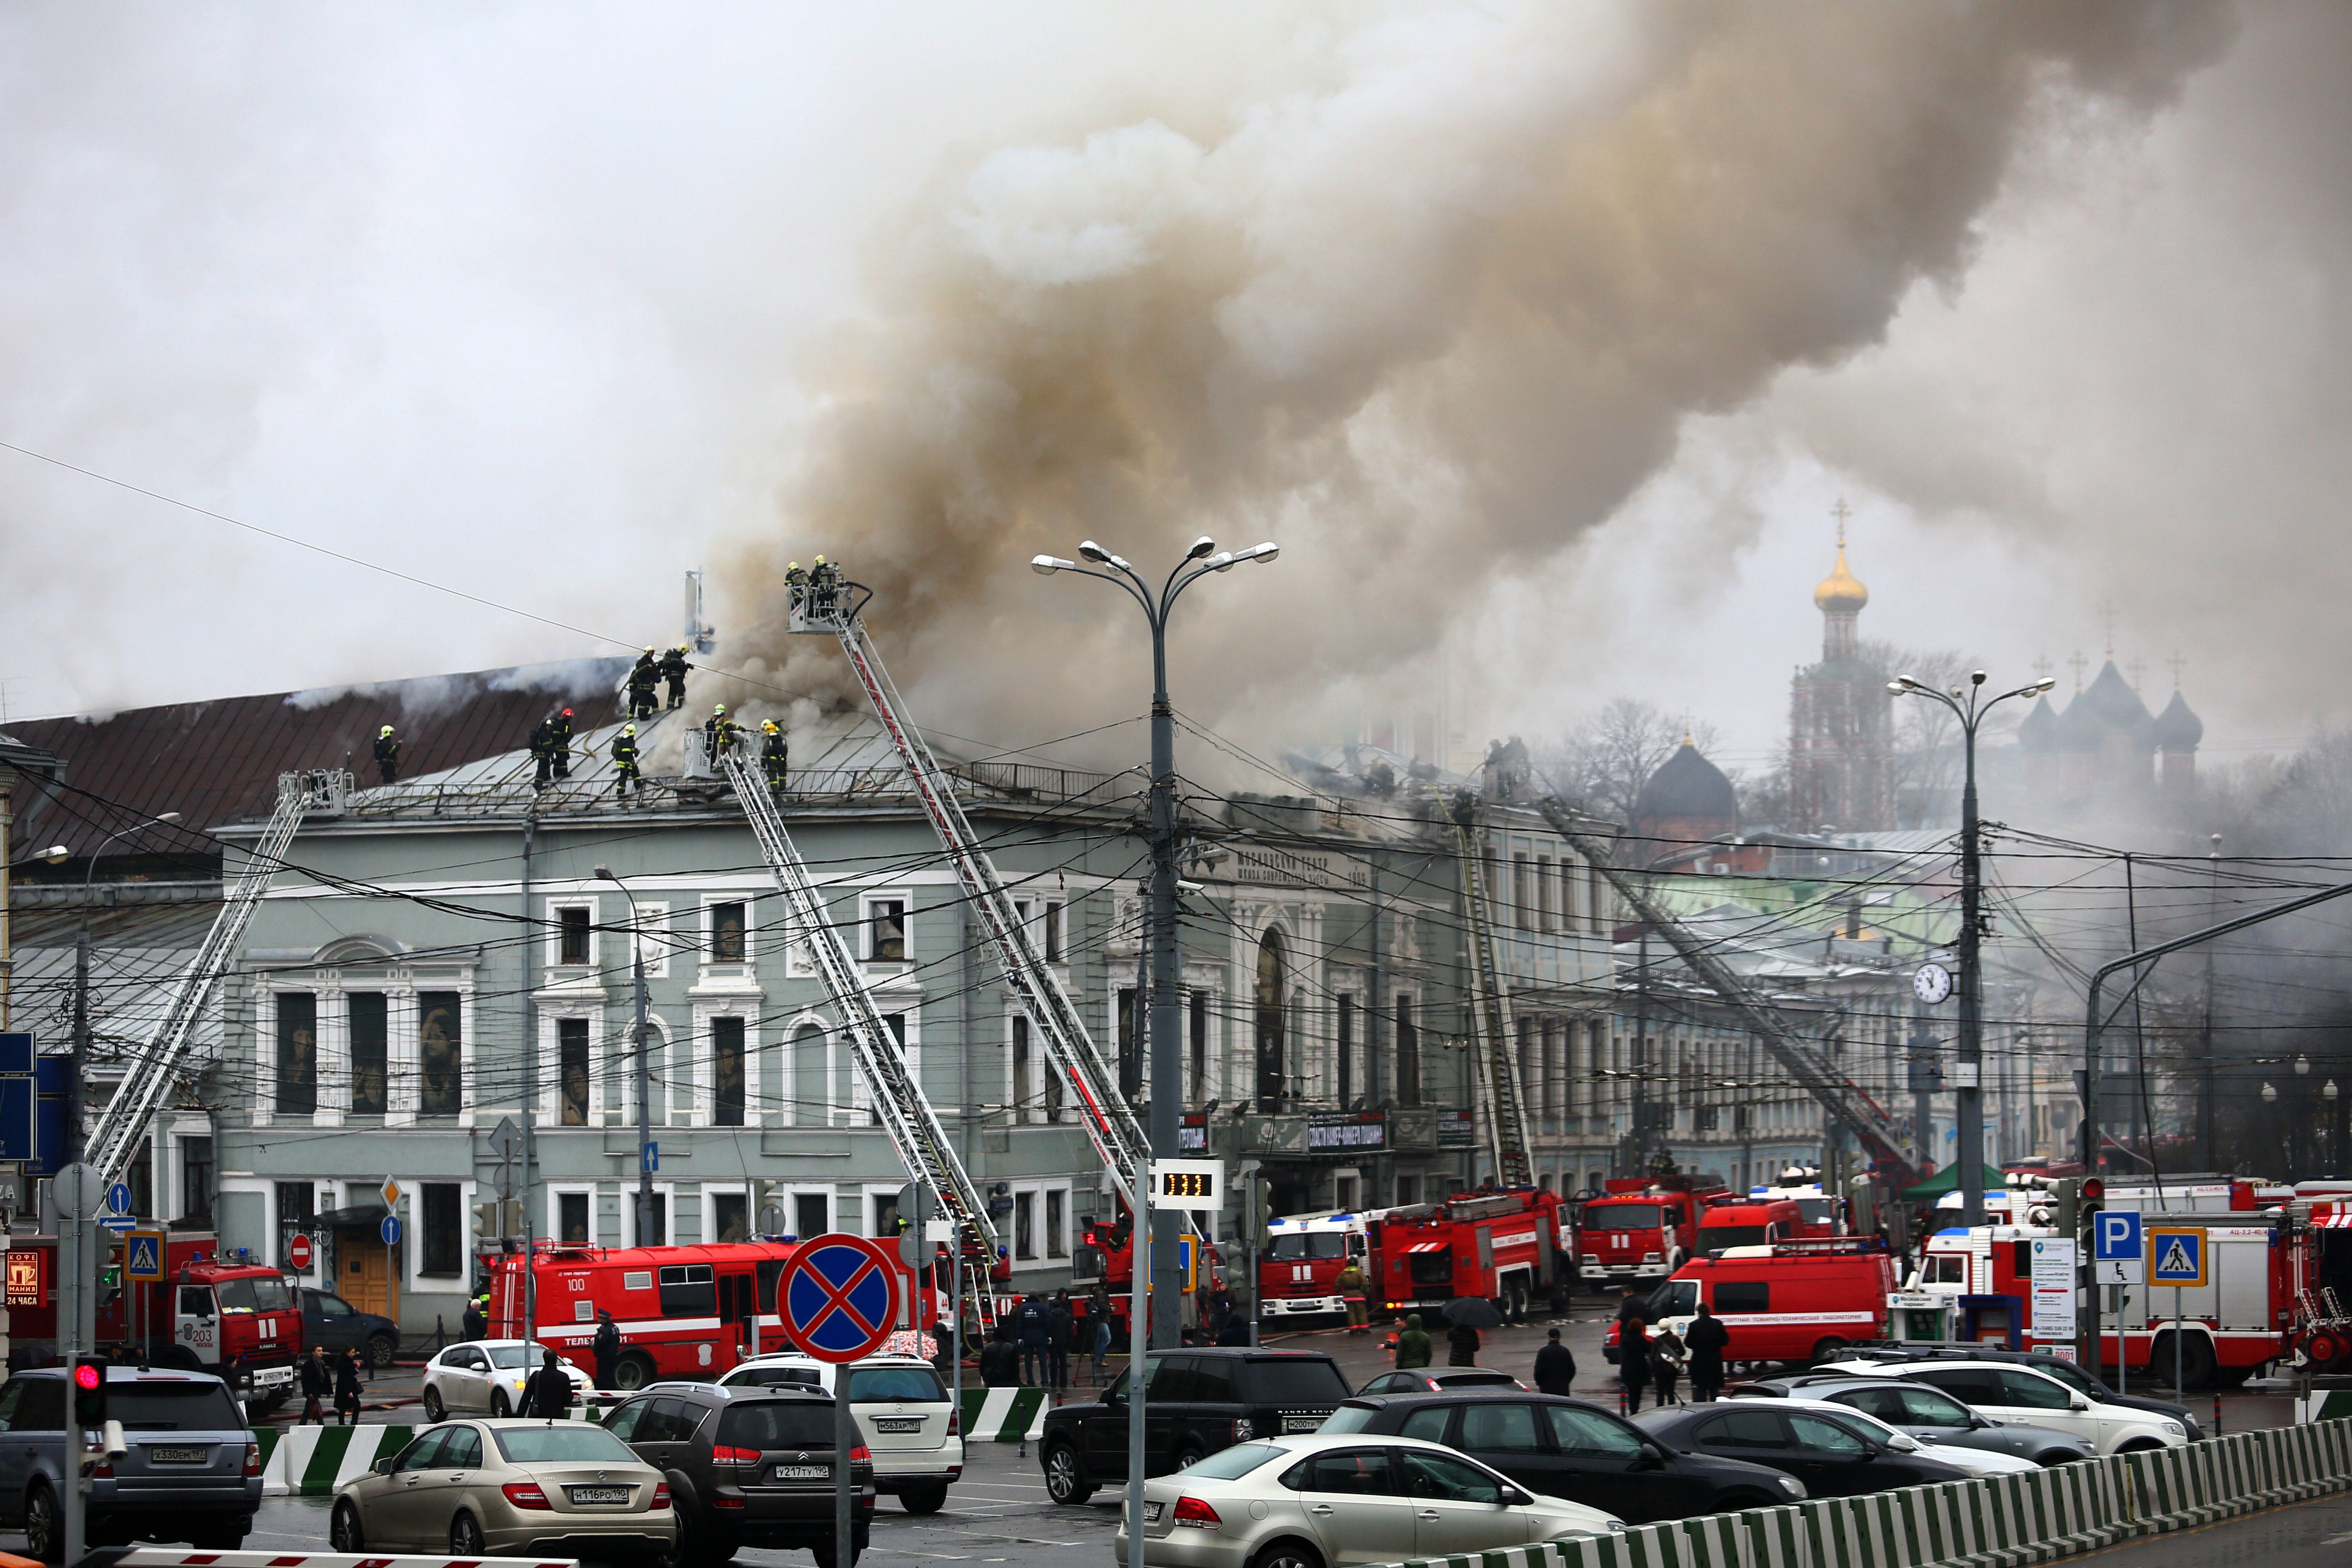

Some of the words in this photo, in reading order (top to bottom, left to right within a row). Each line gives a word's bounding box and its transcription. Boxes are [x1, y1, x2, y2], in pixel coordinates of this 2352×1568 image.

[2106, 1218, 2130, 1254] P
[568, 1278, 585, 1291] 100
[7, 1297, 16, 1305] 24
[18, 1297, 37, 1305] ЧАСА
[192, 1330, 212, 1341] 203
